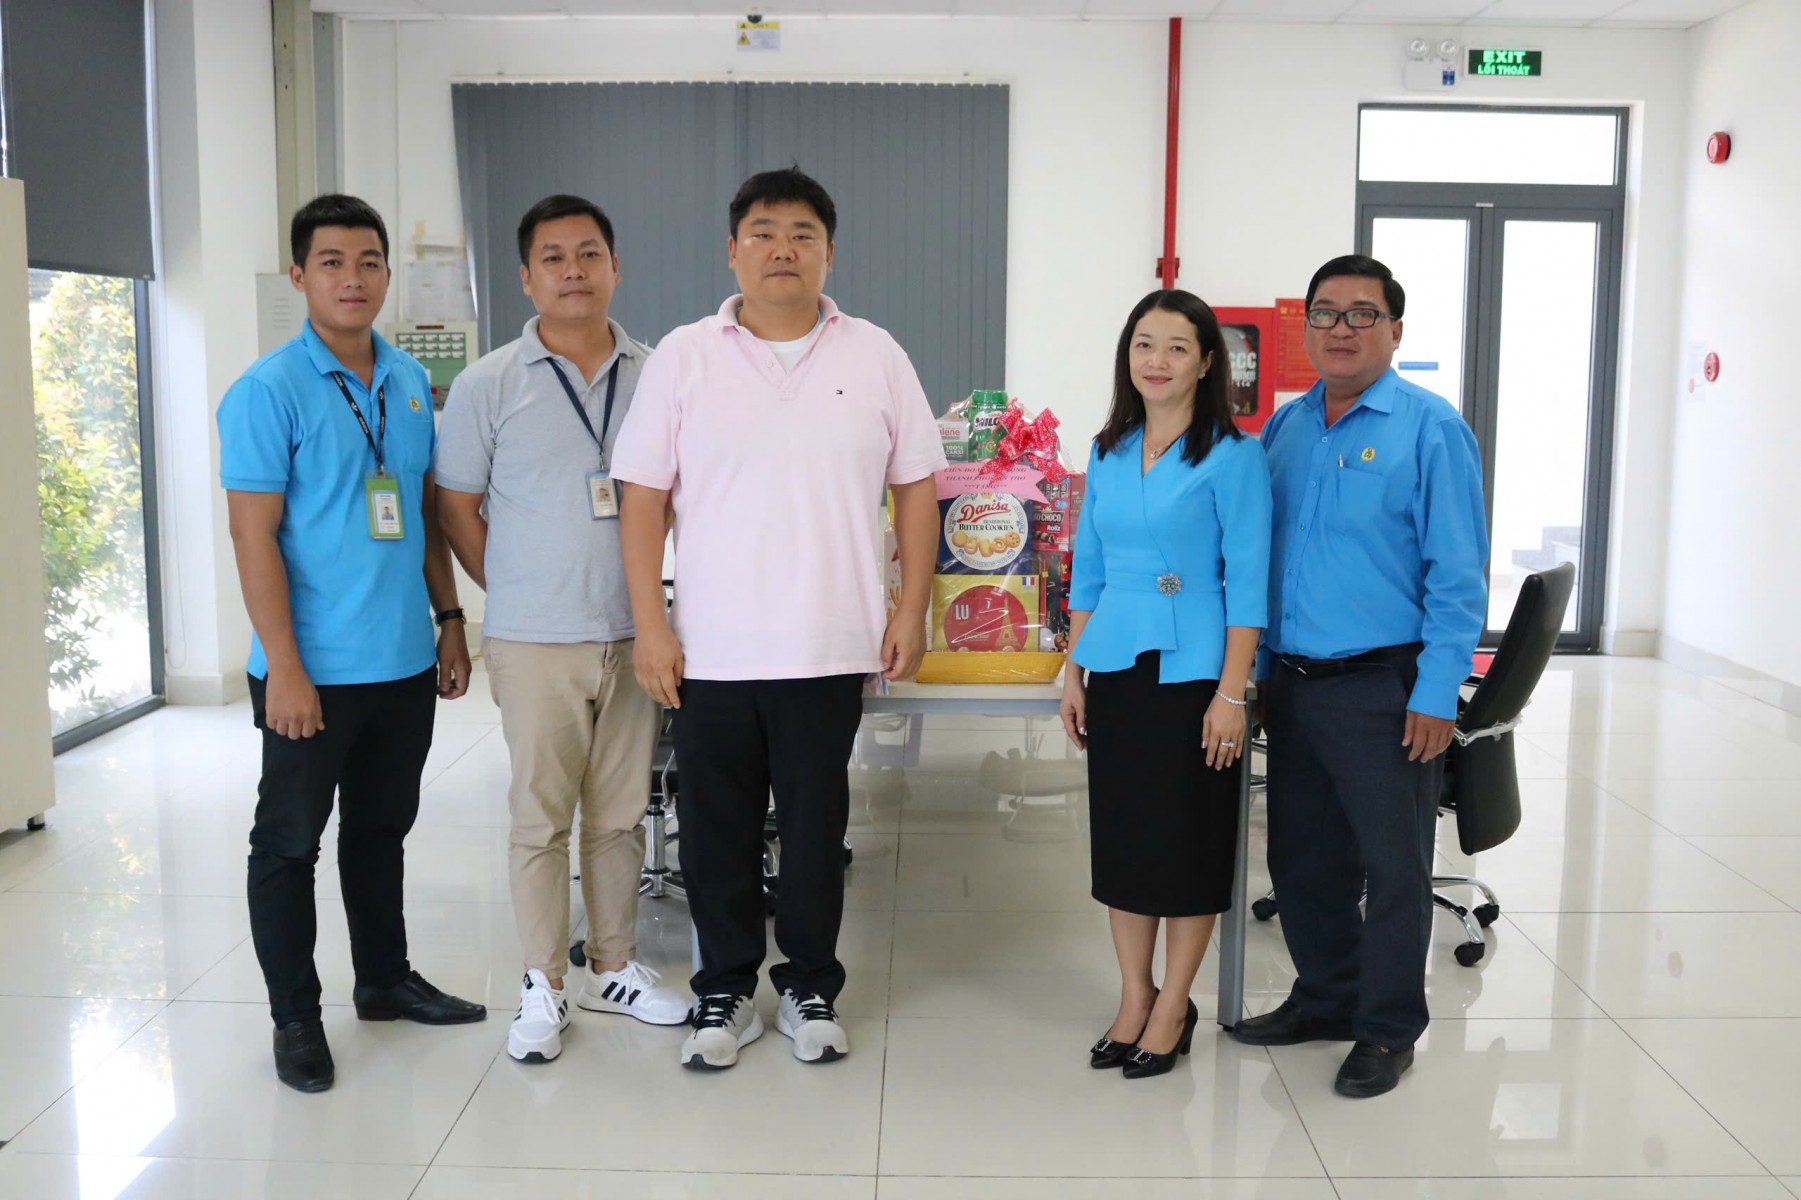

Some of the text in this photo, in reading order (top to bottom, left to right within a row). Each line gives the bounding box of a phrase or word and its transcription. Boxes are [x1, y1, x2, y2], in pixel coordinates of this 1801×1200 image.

[1483, 50, 1525, 63] EXIT
[1478, 61, 1530, 75] LỐI THOÁT
[1229, 352, 1256, 369] CCC
[939, 427, 961, 436] lene
[957, 500, 1011, 523] Danisa
[1041, 513, 1062, 522] CHOCO
[959, 523, 1014, 531] BUTTER COOKIES
[955, 604, 969, 621] LU
